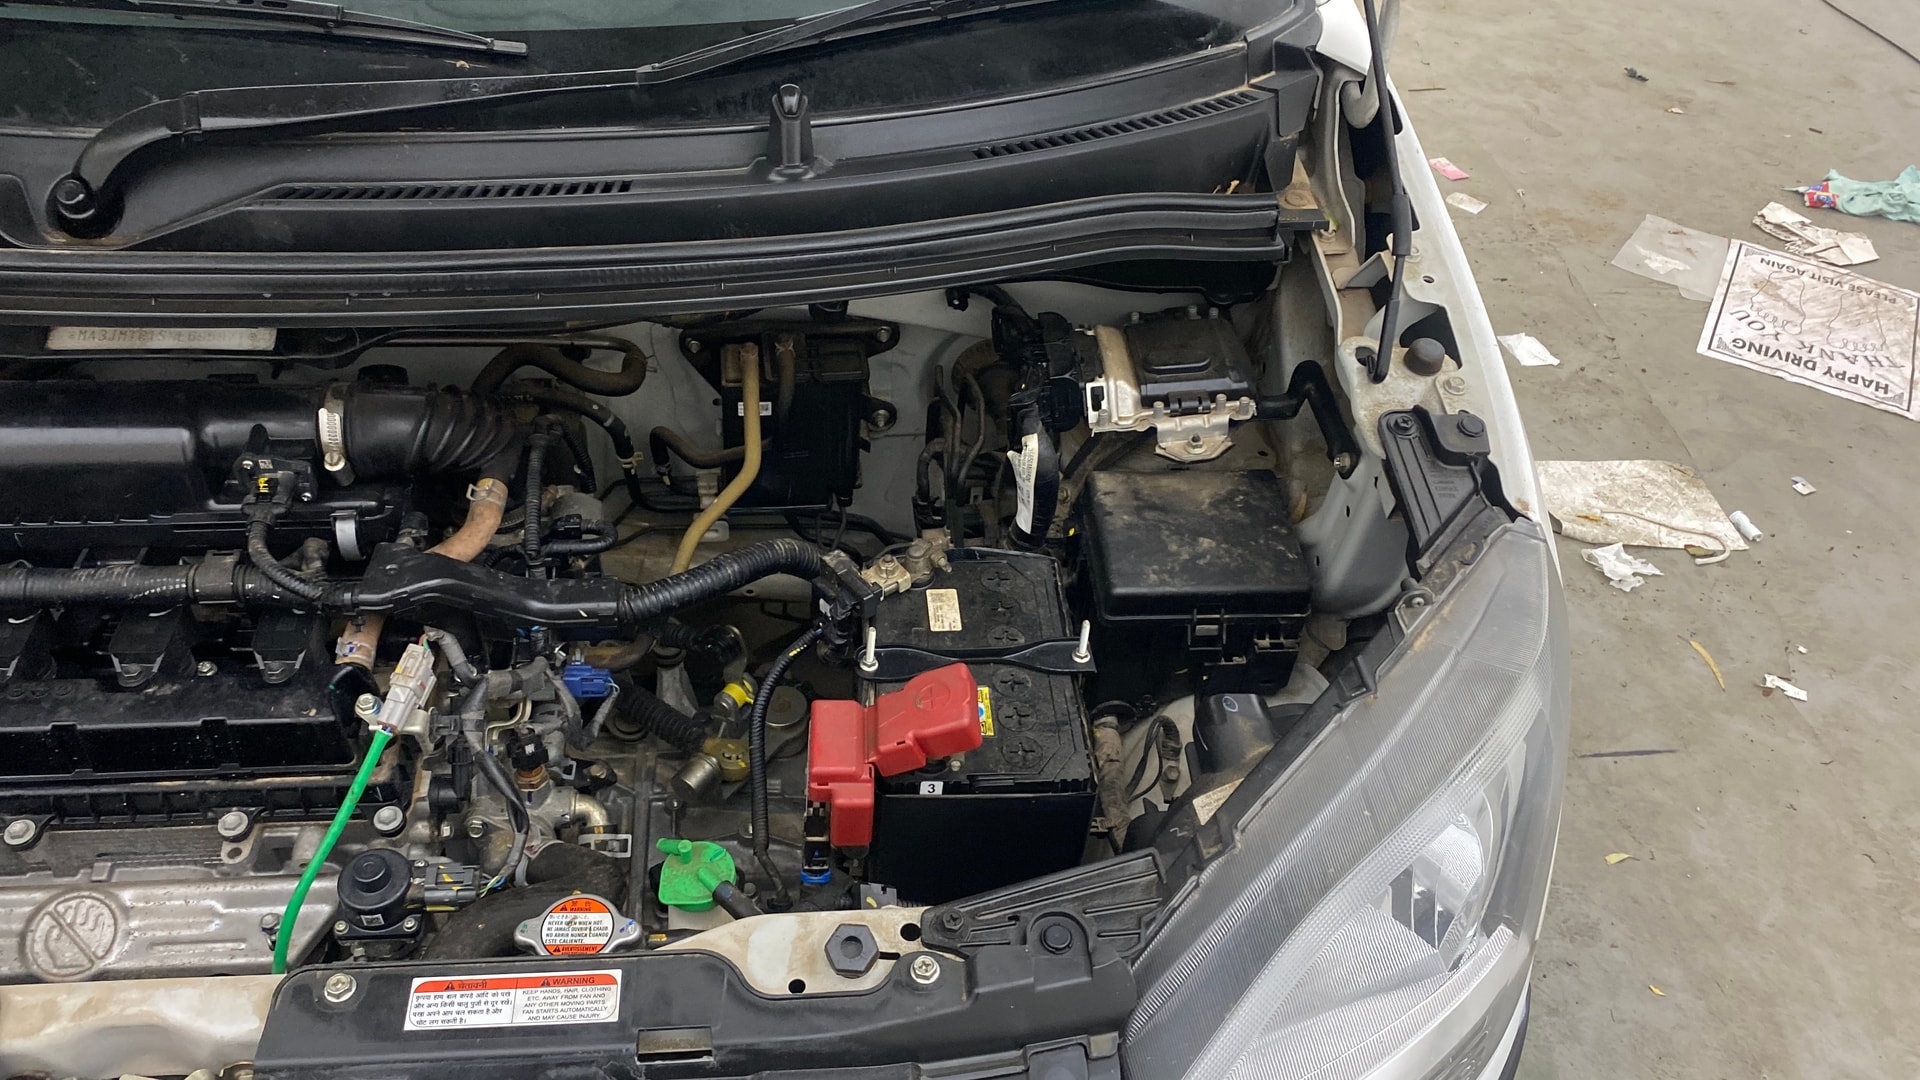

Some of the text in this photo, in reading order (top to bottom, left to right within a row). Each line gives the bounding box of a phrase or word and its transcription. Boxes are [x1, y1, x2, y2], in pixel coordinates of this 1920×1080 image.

[1760, 257, 1897, 304] PLEASE VISIT AGAIN
[1729, 307, 1905, 368] THANK YOU
[1731, 337, 1889, 396] HAPPY DRIVING
[928, 784, 936, 794] 3
[553, 977, 595, 985] WARNING
